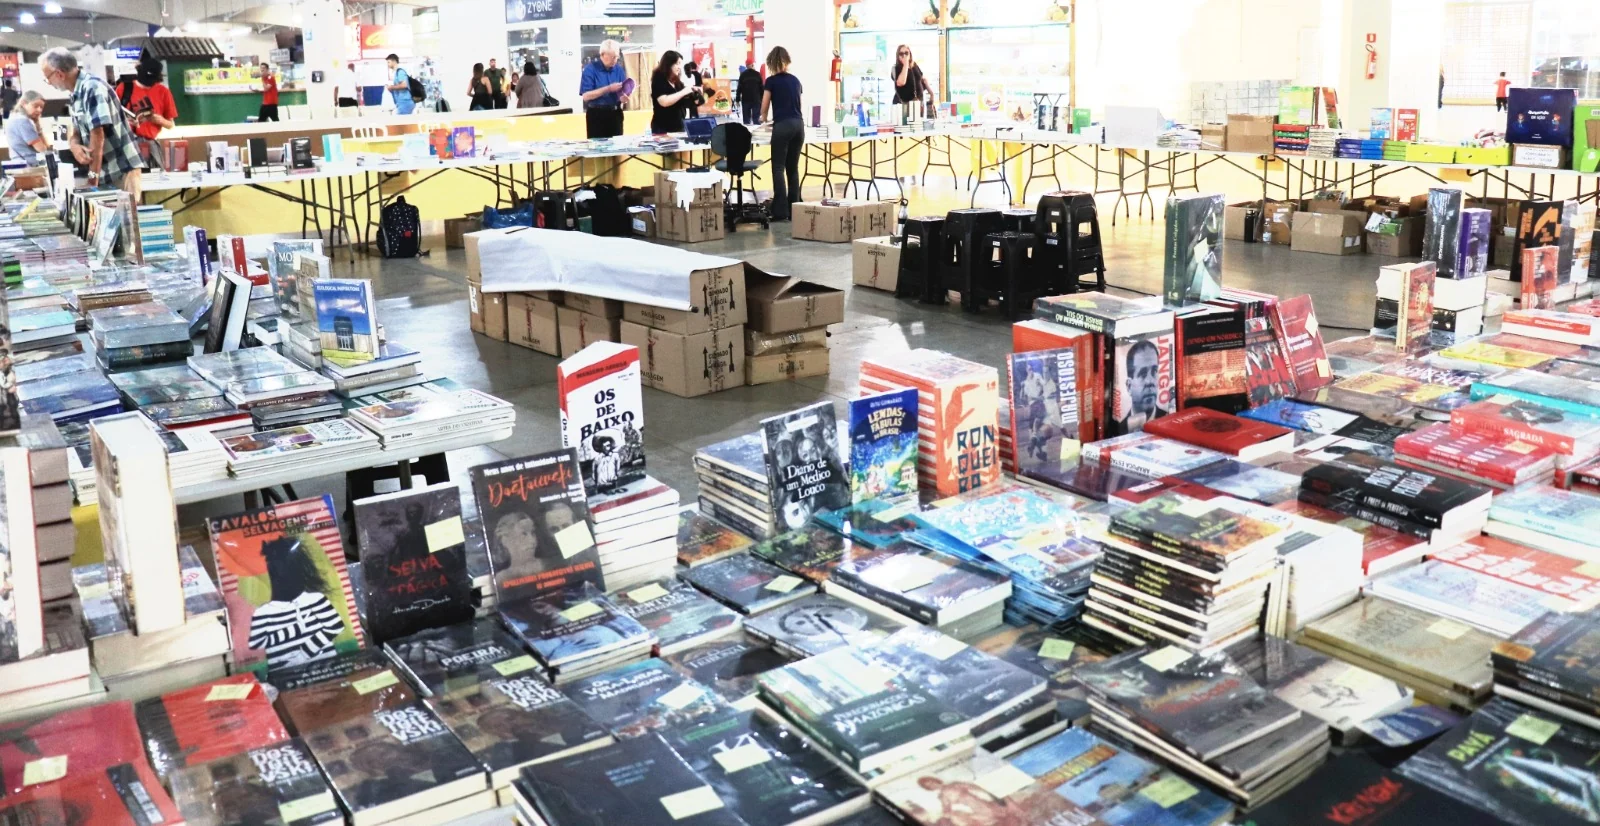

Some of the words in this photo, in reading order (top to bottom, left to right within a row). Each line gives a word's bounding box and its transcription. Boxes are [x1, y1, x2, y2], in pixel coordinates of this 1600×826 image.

[527, 0, 552, 14] ZYONE
[1156, 336, 1170, 404] JANGO
[594, 388, 616, 404] OS
[1057, 351, 1078, 424] MAJESTOSO
[596, 403, 616, 418] DE
[868, 406, 903, 424] LENDAS
[580, 411, 634, 442] BAIXO
[1504, 428, 1544, 444] SAGRADA
[956, 424, 994, 451] RON
[515, 462, 524, 470] de
[817, 458, 827, 468] de
[957, 446, 996, 475] QUEI
[786, 481, 800, 490] um
[798, 484, 826, 499] Louco
[958, 473, 981, 494] RO
[210, 510, 276, 531] CAVALOS
[243, 515, 307, 537] SELVAGENS
[389, 554, 443, 576] SELVA
[496, 676, 530, 694] DOS
[512, 688, 560, 708] VSKI
[379, 706, 420, 726] DOS
[392, 720, 442, 740] VSKI
[252, 745, 296, 765] DOS
[260, 761, 312, 782] VSKI
